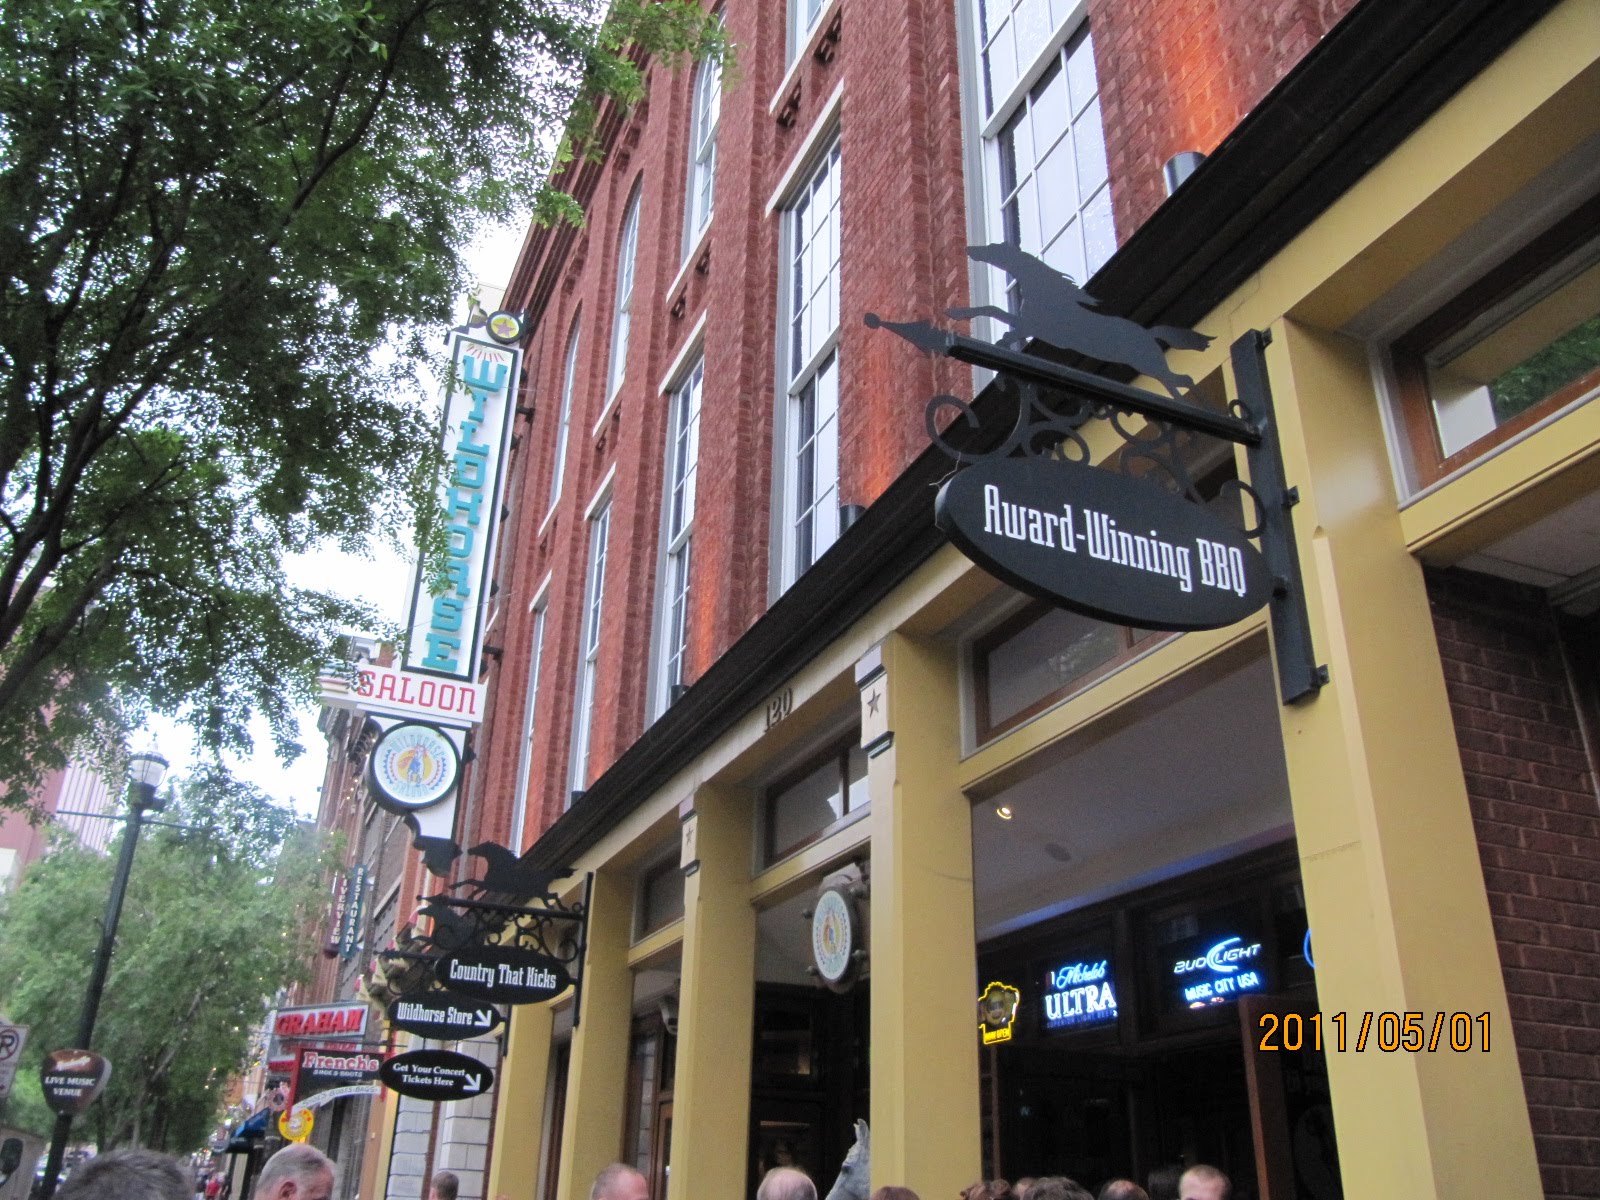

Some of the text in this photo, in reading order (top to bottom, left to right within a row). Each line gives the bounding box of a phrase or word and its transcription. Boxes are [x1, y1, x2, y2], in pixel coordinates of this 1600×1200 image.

[421, 355, 508, 672] WILDHORSE
[984, 484, 1247, 598] Award-Winning BBQ
[357, 670, 476, 715] SALOON
[330, 873, 348, 944] IVERVIEW
[345, 867, 364, 952] RESTAURANT
[1174, 943, 1261, 974] BUD LIGHT
[450, 958, 557, 989] Country That Kicks
[1056, 960, 1107, 988] Michelob
[1184, 972, 1259, 1001] MUSIC CITY USA
[397, 1002, 473, 1025] Wildhorse Store
[1045, 981, 1117, 1020] ULTRA
[276, 1009, 365, 1036] GRAHAM
[302, 1051, 379, 1071] French's
[392, 1063, 465, 1076] Get Your Concert
[44, 1076, 96, 1086] LIVE MUSIC
[53, 1087, 83, 1097] VENUE
[402, 1074, 454, 1086] Tickets Here
